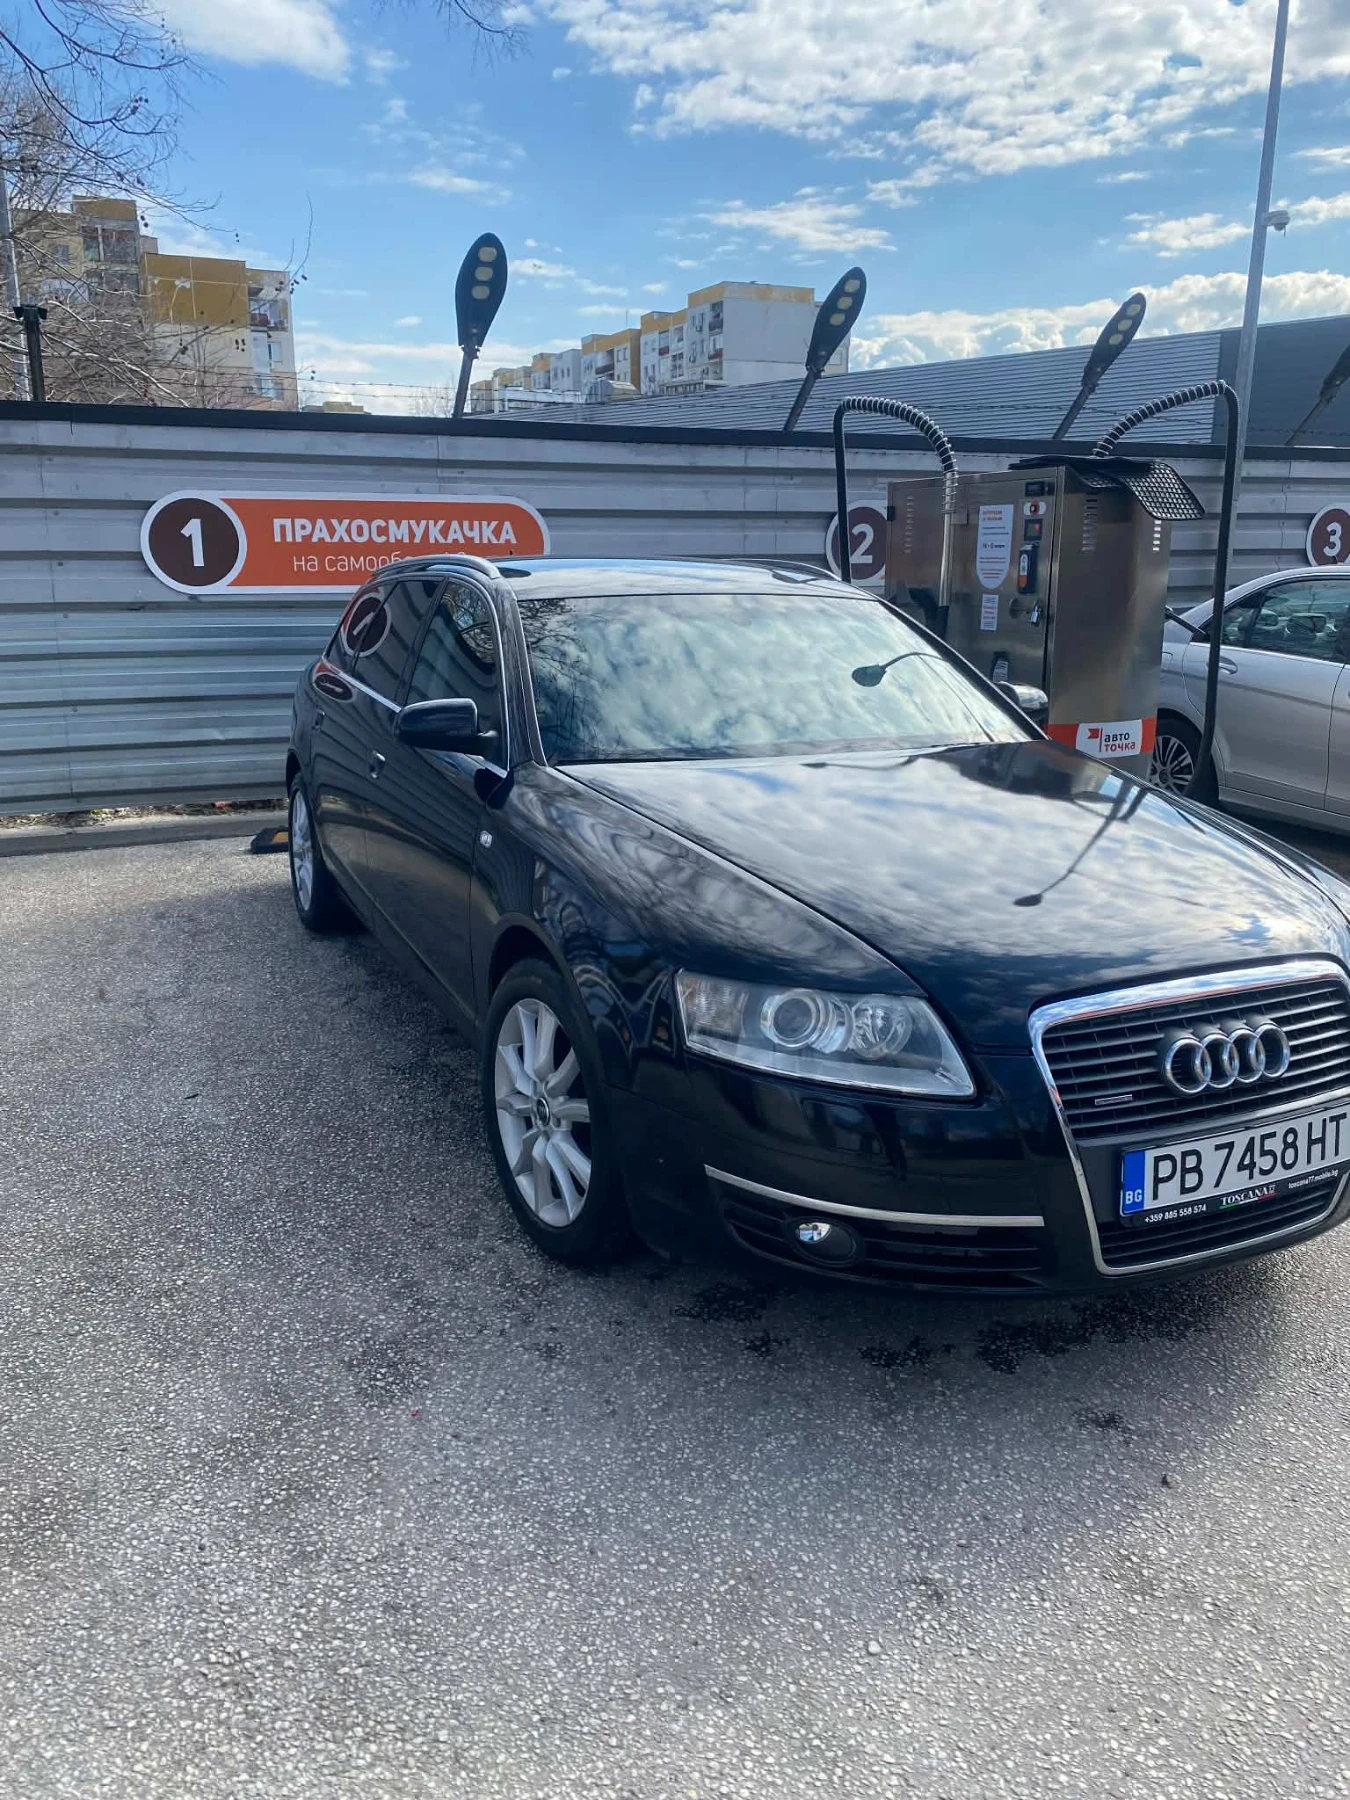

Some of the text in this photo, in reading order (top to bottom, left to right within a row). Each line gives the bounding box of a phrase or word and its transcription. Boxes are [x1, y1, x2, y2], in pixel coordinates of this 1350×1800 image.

[273, 518, 517, 544] ПРАХОСМУКАЧКА
[1323, 522, 1342, 557] 3
[180, 518, 204, 568] 1
[850, 523, 874, 564] 2
[293, 555, 318, 572] на
[1104, 732, 1130, 743] авто
[1104, 742, 1136, 752] точка
[1214, 1127, 1299, 1188] 7458
[1125, 1189, 1143, 1205] BG
[1221, 1187, 1268, 1206] TOSCANA
[1145, 1213, 1164, 1223] +359
